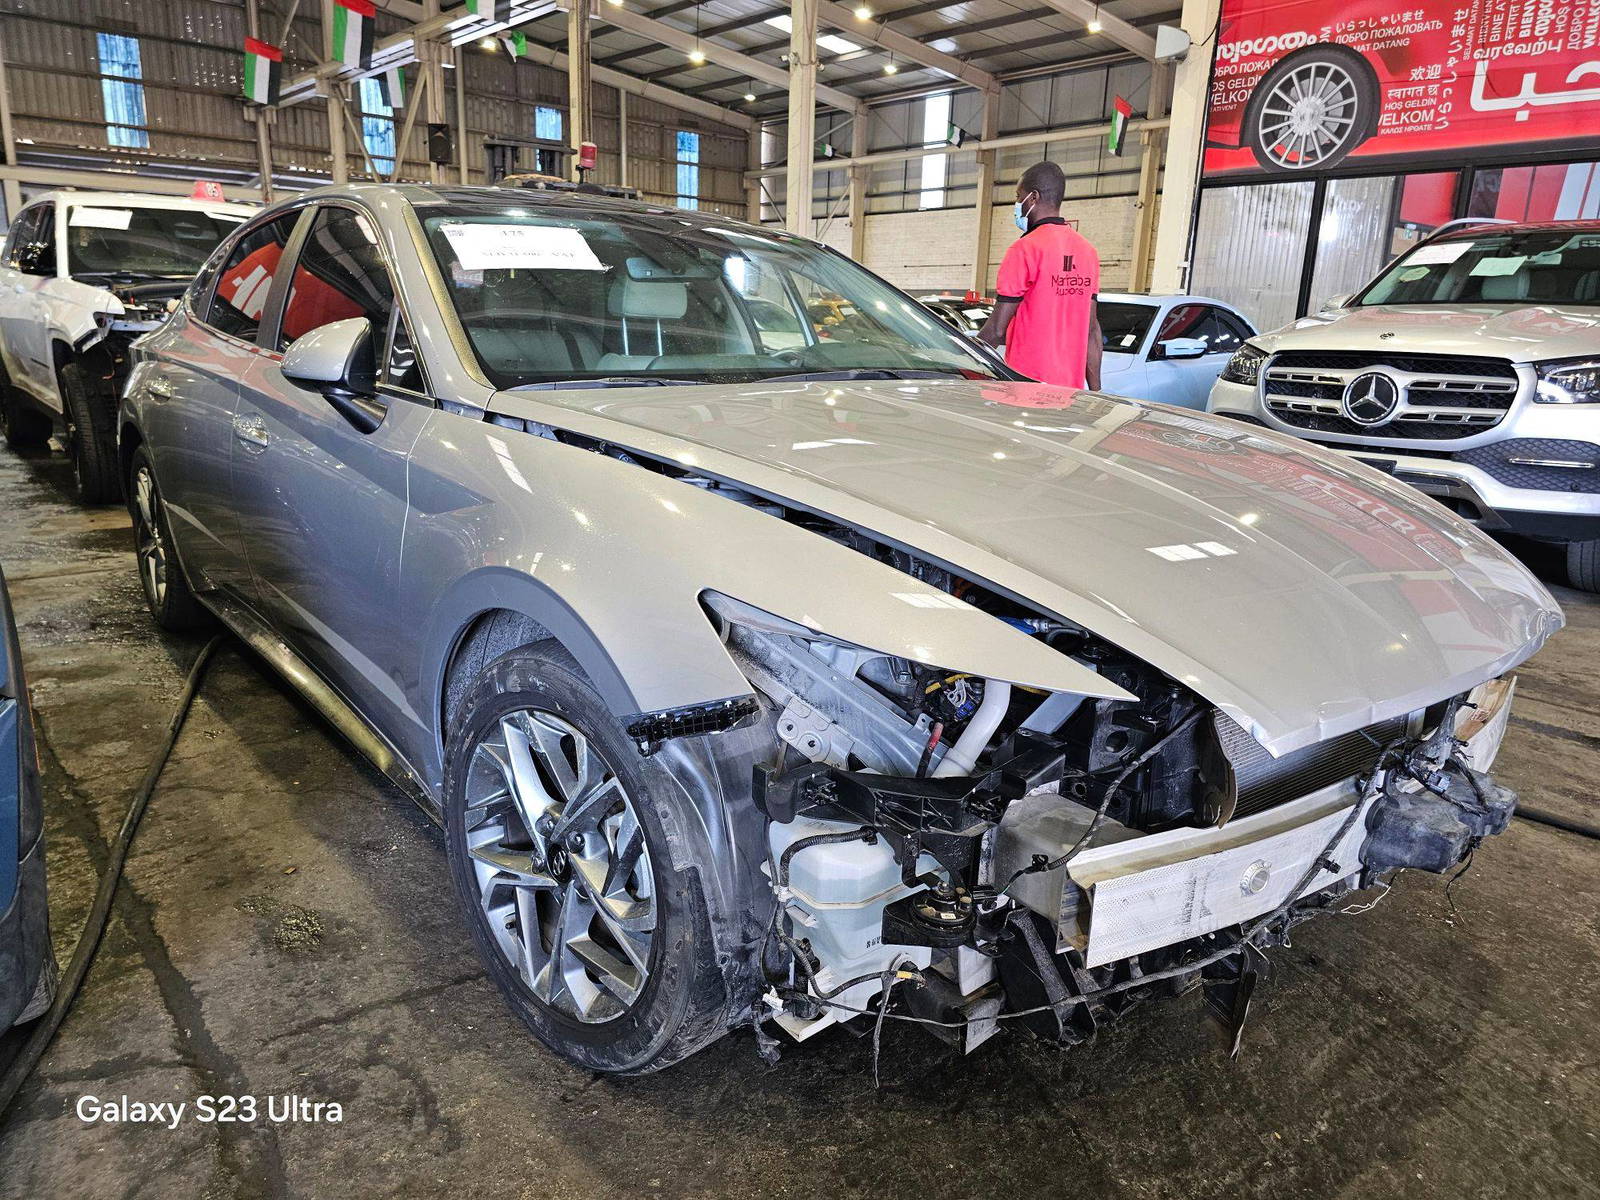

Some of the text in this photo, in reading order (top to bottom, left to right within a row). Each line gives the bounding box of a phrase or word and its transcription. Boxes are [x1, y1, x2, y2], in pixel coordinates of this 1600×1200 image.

[1335, 9, 1424, 34] いらっしゃいませ
[1369, 20, 1443, 39] ПОЖАЛОВАТЬ
[1489, 13, 1505, 42] BINE
[1567, 7, 1586, 50] ДОБРО
[1373, 37, 1411, 51] DATANG
[1409, 64, 1441, 81] 欢迎
[1211, 89, 1253, 106] ELKO
[1377, 109, 1435, 126] ELKOM
